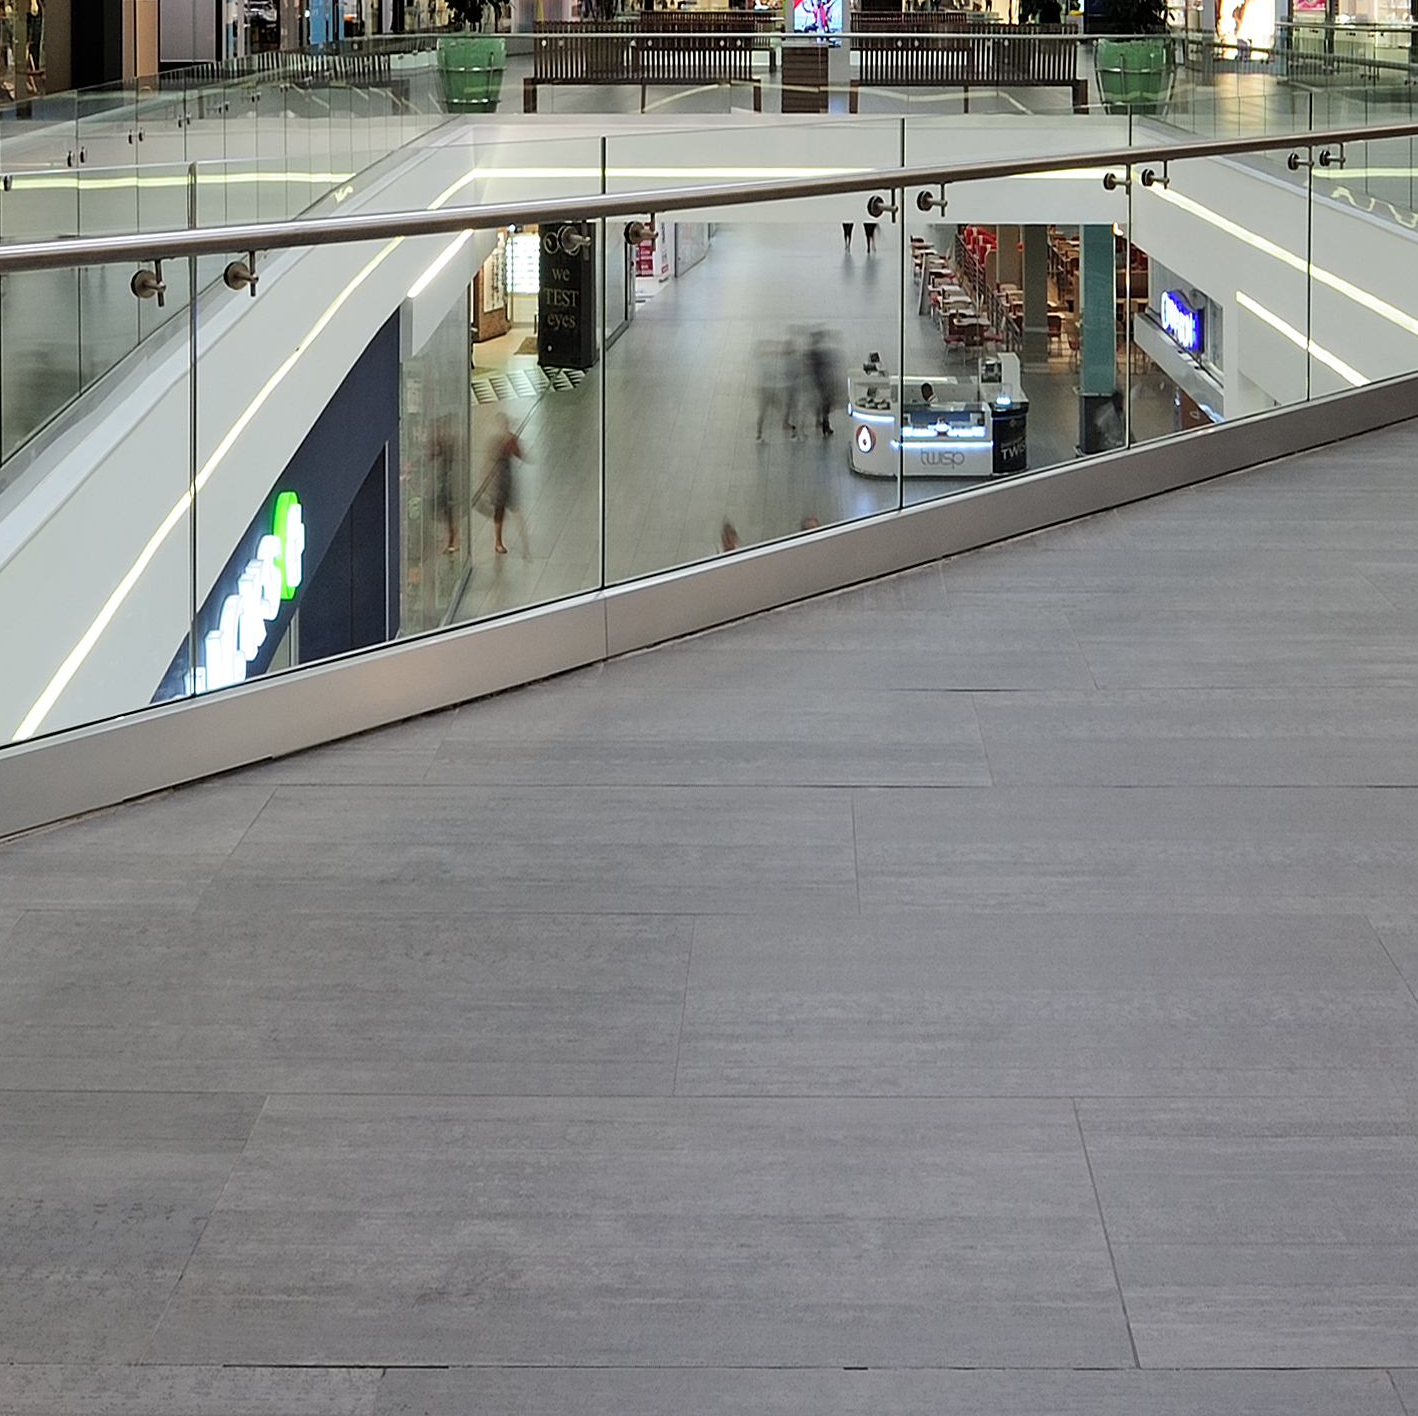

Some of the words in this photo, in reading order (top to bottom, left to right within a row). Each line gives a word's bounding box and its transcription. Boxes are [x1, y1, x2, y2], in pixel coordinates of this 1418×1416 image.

[551, 267, 572, 282] we
[543, 287, 580, 307] TEST
[547, 312, 576, 331] eyes
